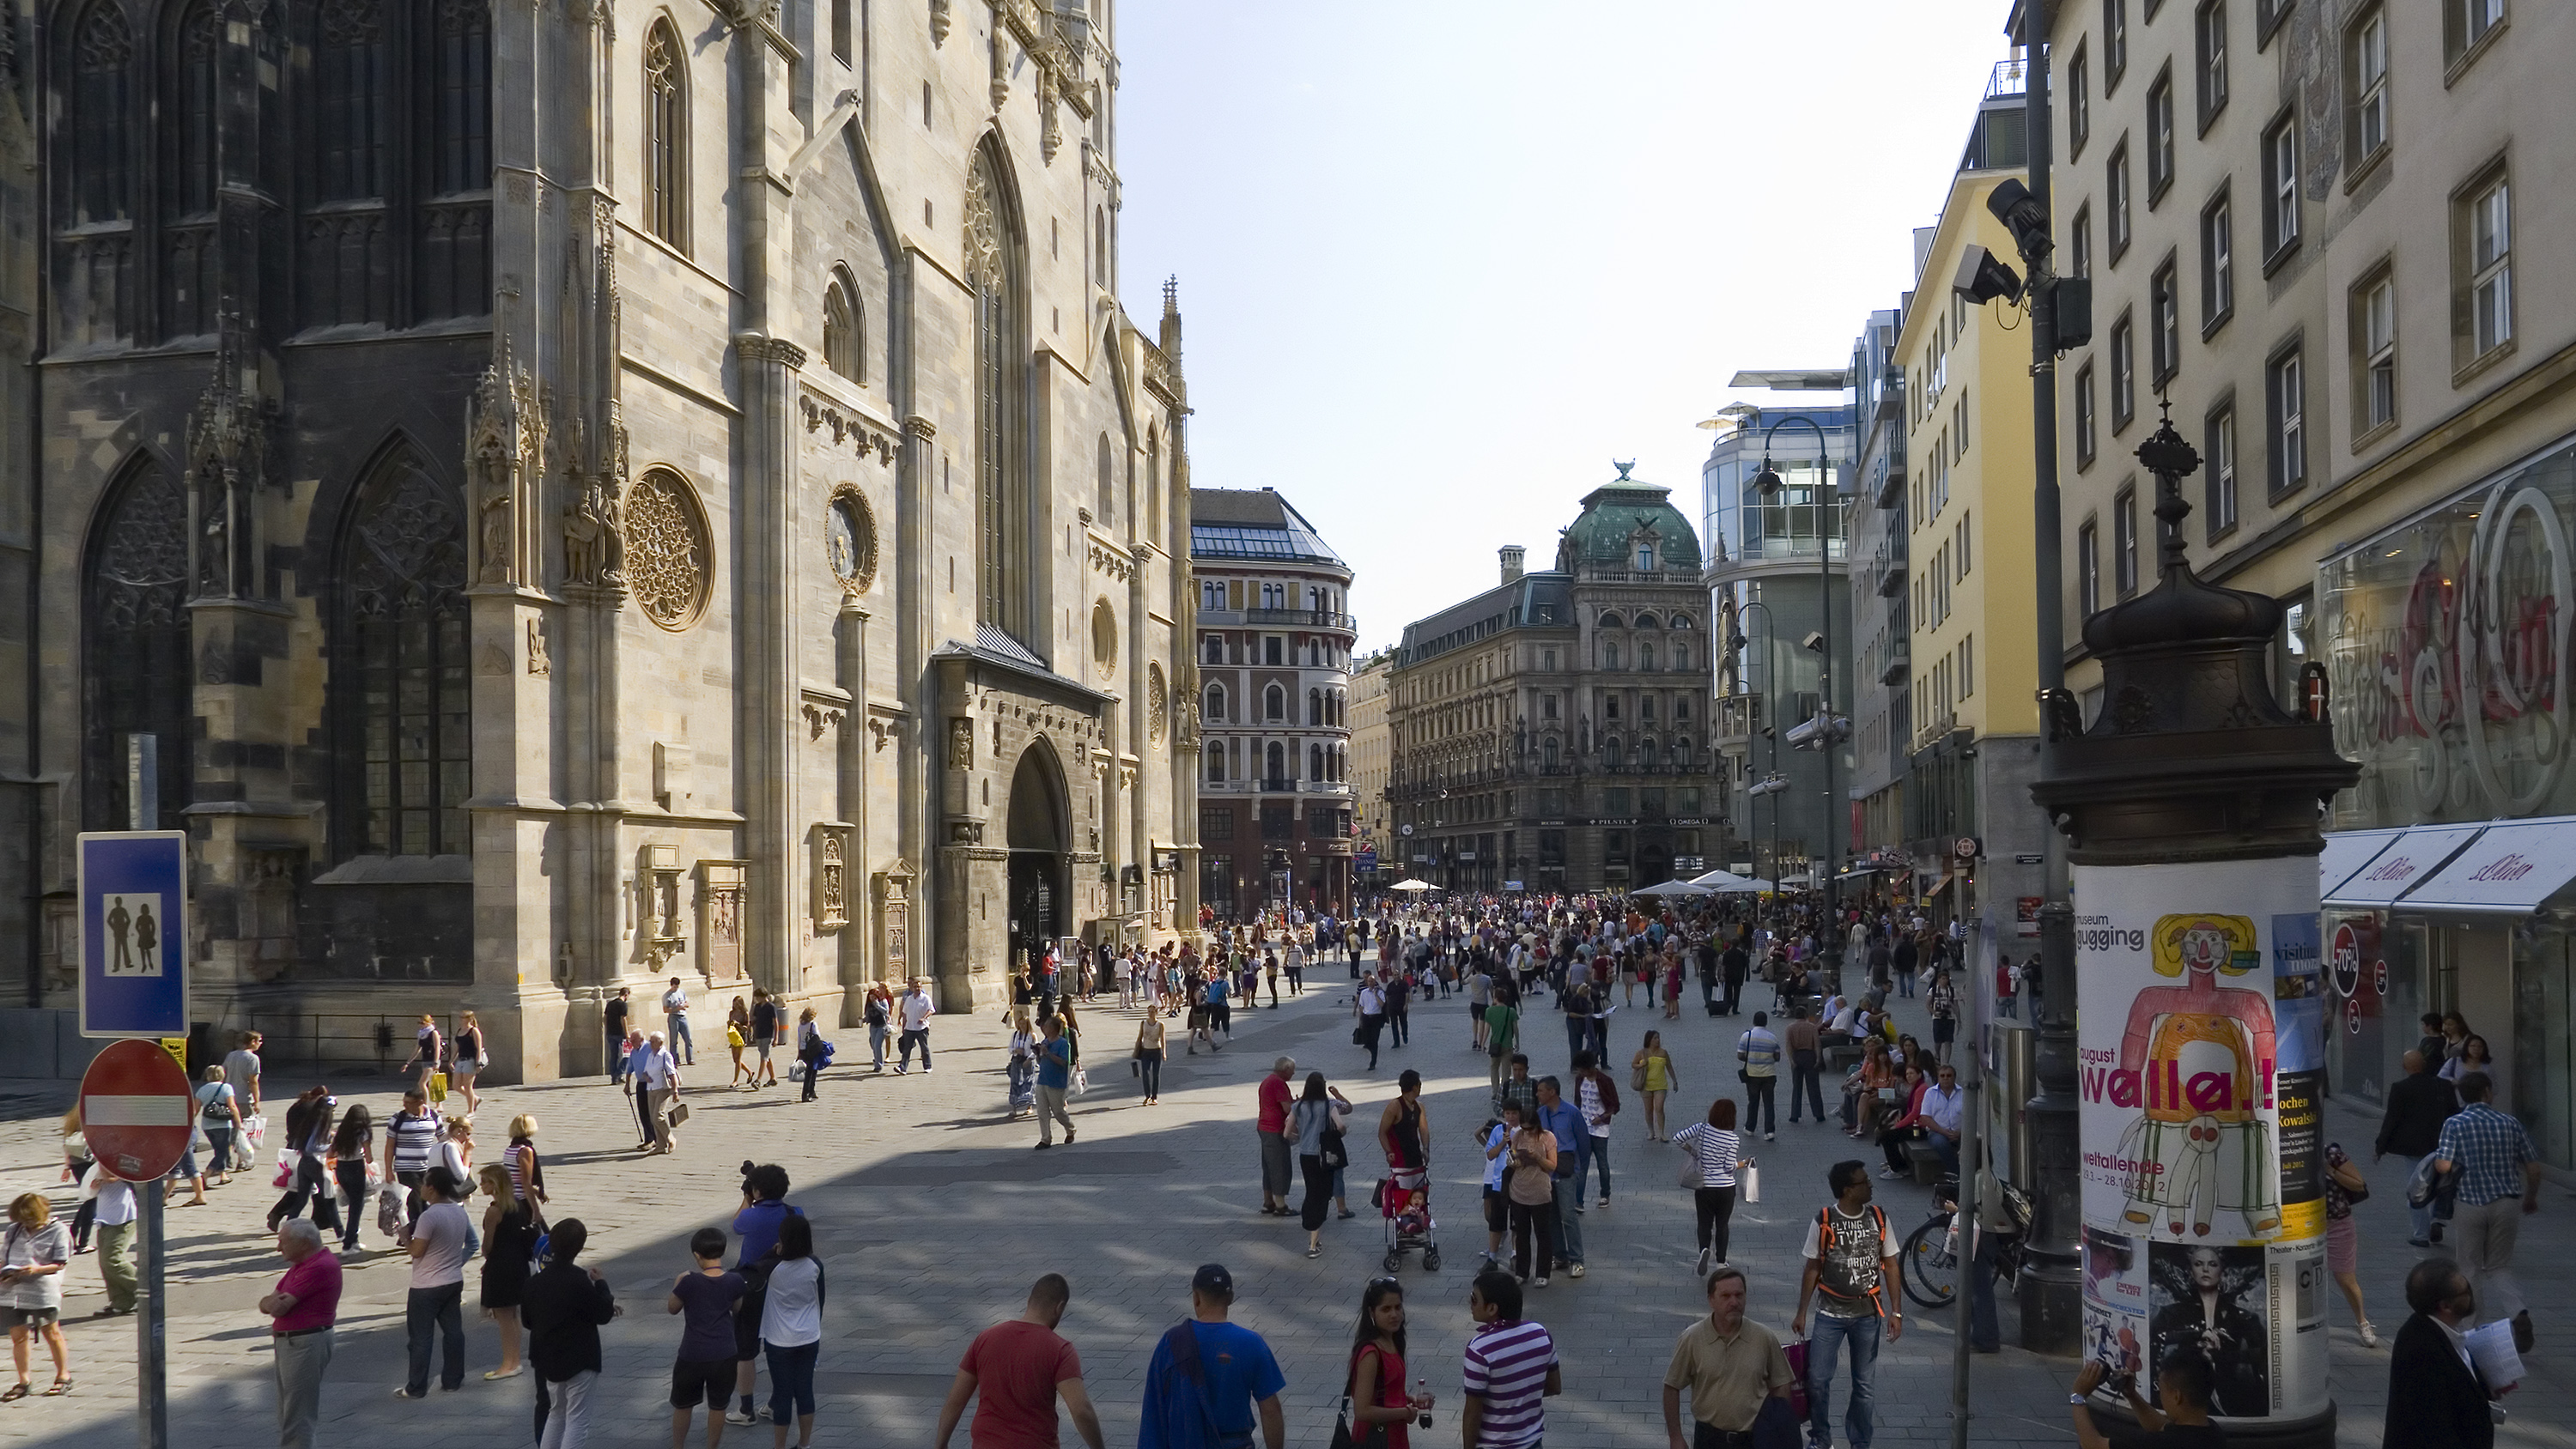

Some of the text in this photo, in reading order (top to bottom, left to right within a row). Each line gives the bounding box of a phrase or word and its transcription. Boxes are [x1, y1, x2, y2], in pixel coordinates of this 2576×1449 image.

[2468, 852, 2534, 882] s.Oliver
[2077, 925, 2145, 952] gugging
[2334, 948, 2357, 973] -70%
[2080, 1046, 2116, 1065] august
[2082, 1151, 2165, 1175] weltallende
[1831, 1220, 1863, 1233] FLYING
